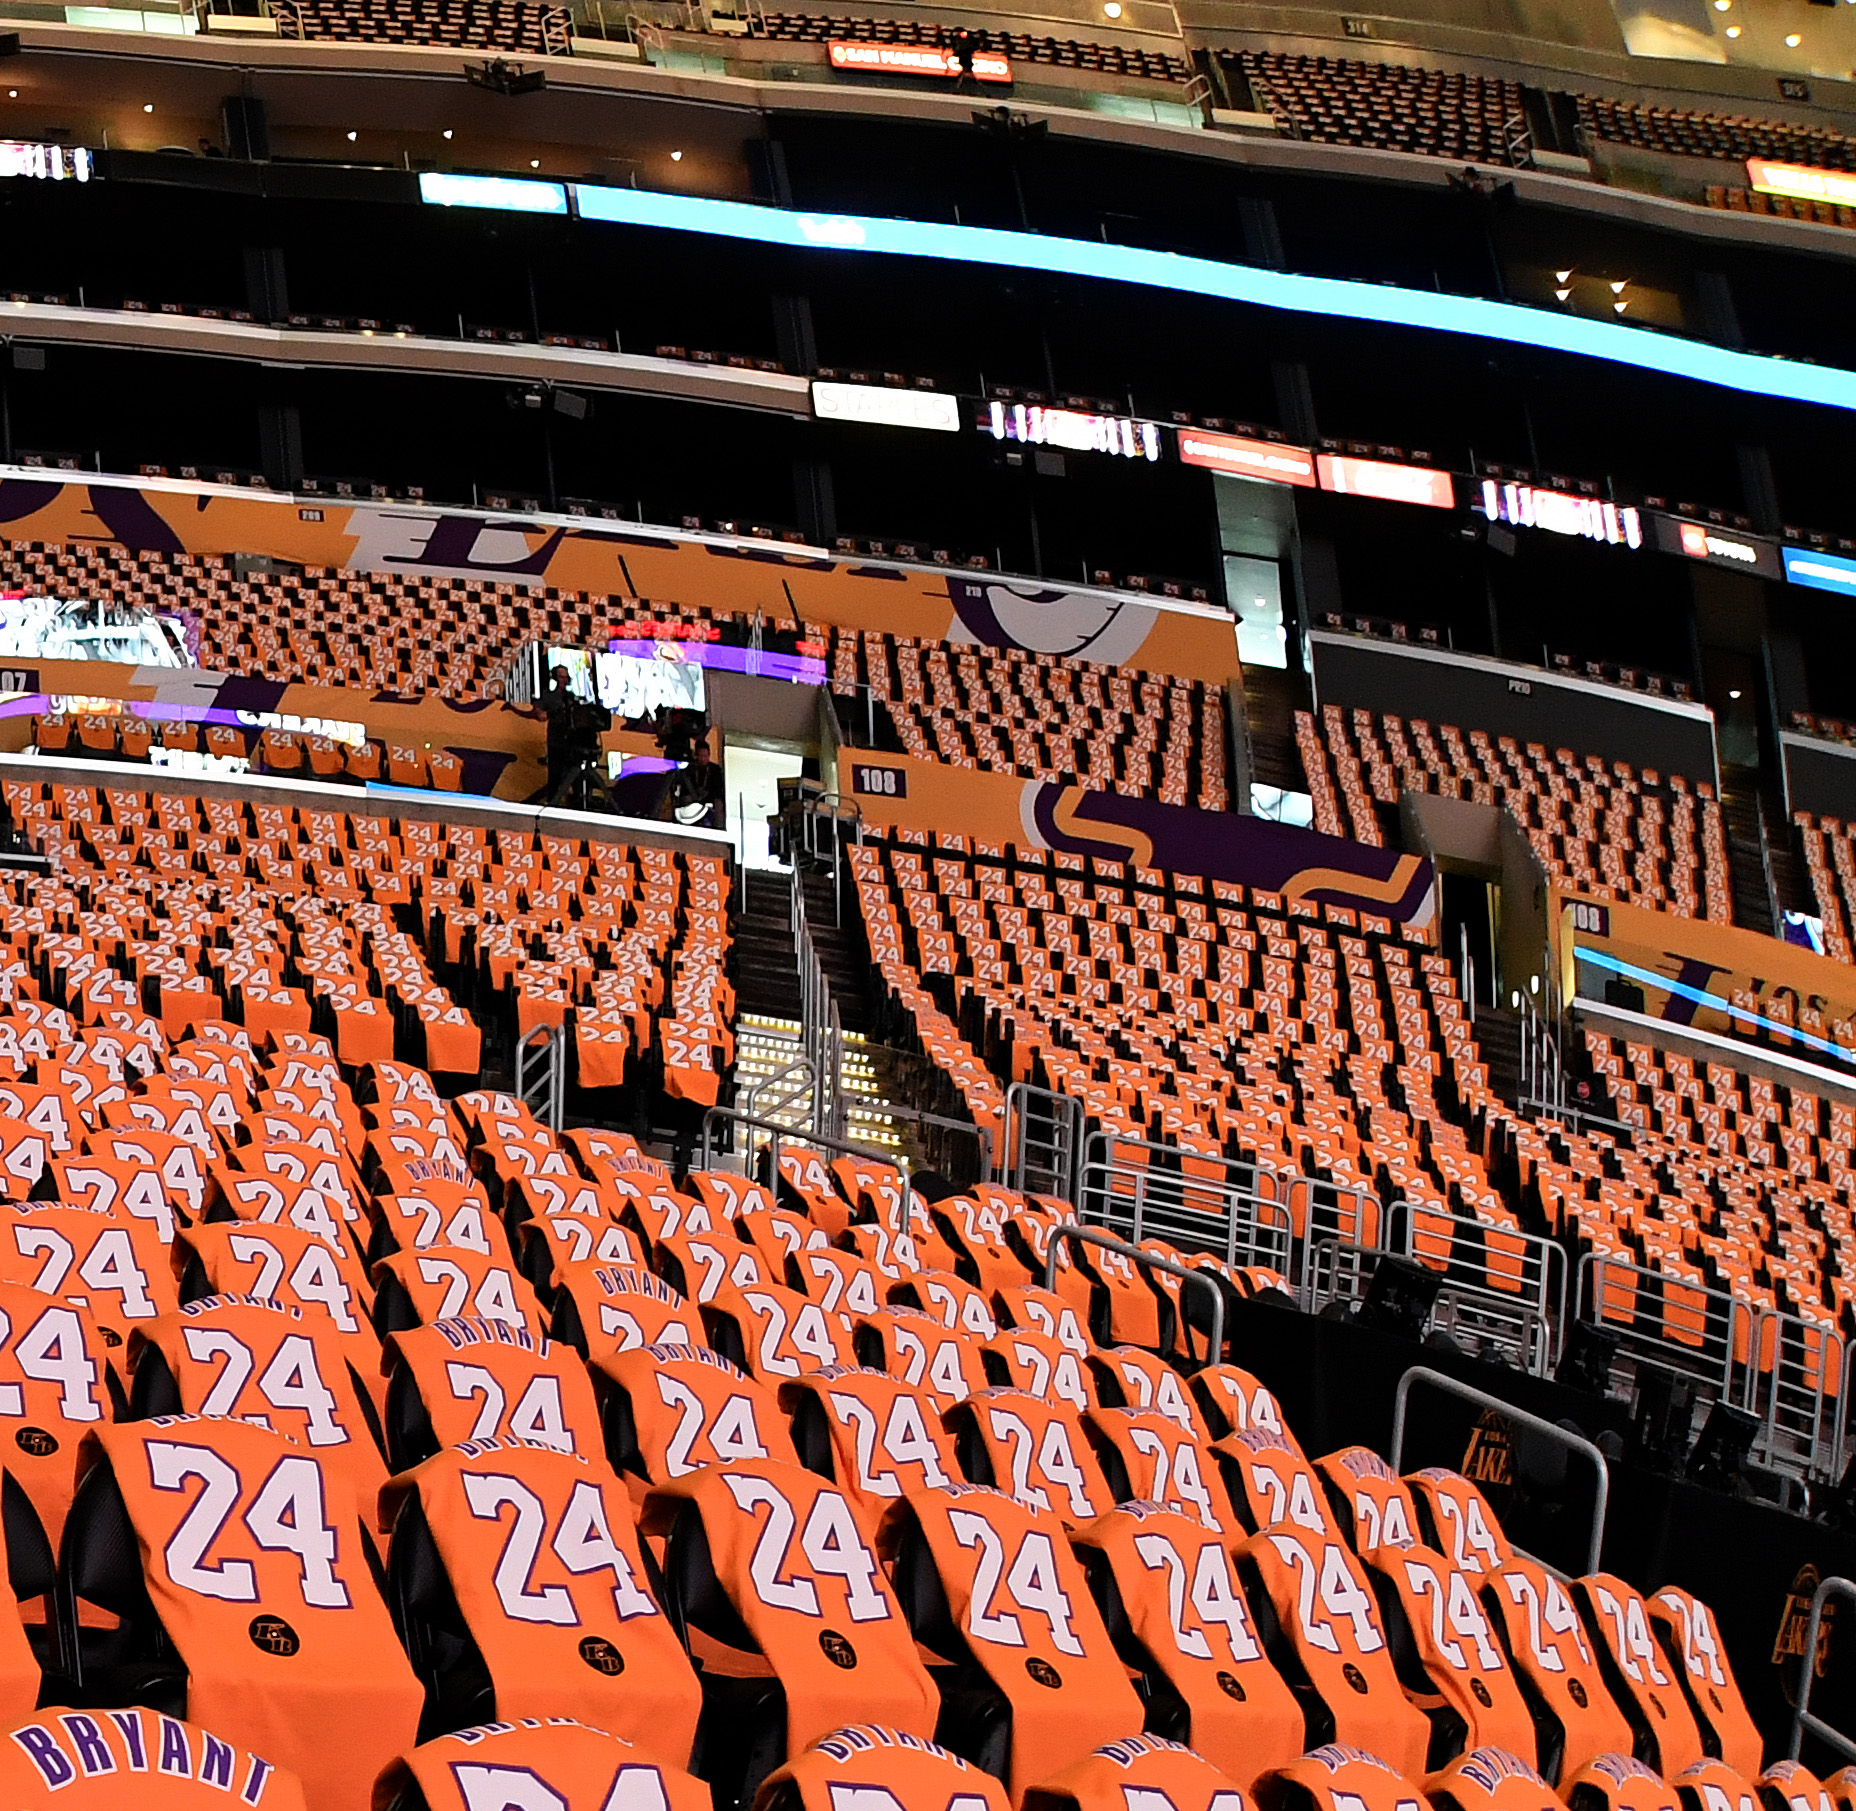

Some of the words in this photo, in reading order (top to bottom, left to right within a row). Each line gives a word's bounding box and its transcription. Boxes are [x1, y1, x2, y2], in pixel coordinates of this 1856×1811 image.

[861, 769, 895, 793] 108
[857, 867, 878, 882] 24
[668, 1040, 710, 1069] 24
[1437, 1001, 1457, 1018] 24
[13, 1223, 158, 1321] 24
[439, 1316, 550, 1359] BRYANT
[740, 1292, 837, 1377] 24
[655, 1371, 791, 1478] 24
[831, 1393, 954, 1498] 24
[144, 1438, 354, 1609] 24
[460, 1470, 658, 1629] 24
[724, 1474, 890, 1623] 24
[948, 1509, 1089, 1659] 24
[1133, 1531, 1264, 1662] 24
[1272, 1533, 1389, 1655] 24
[1403, 1561, 1503, 1670] 24
[1503, 1573, 1592, 1673] 24
[11, 1711, 276, 1808] BRYANT
